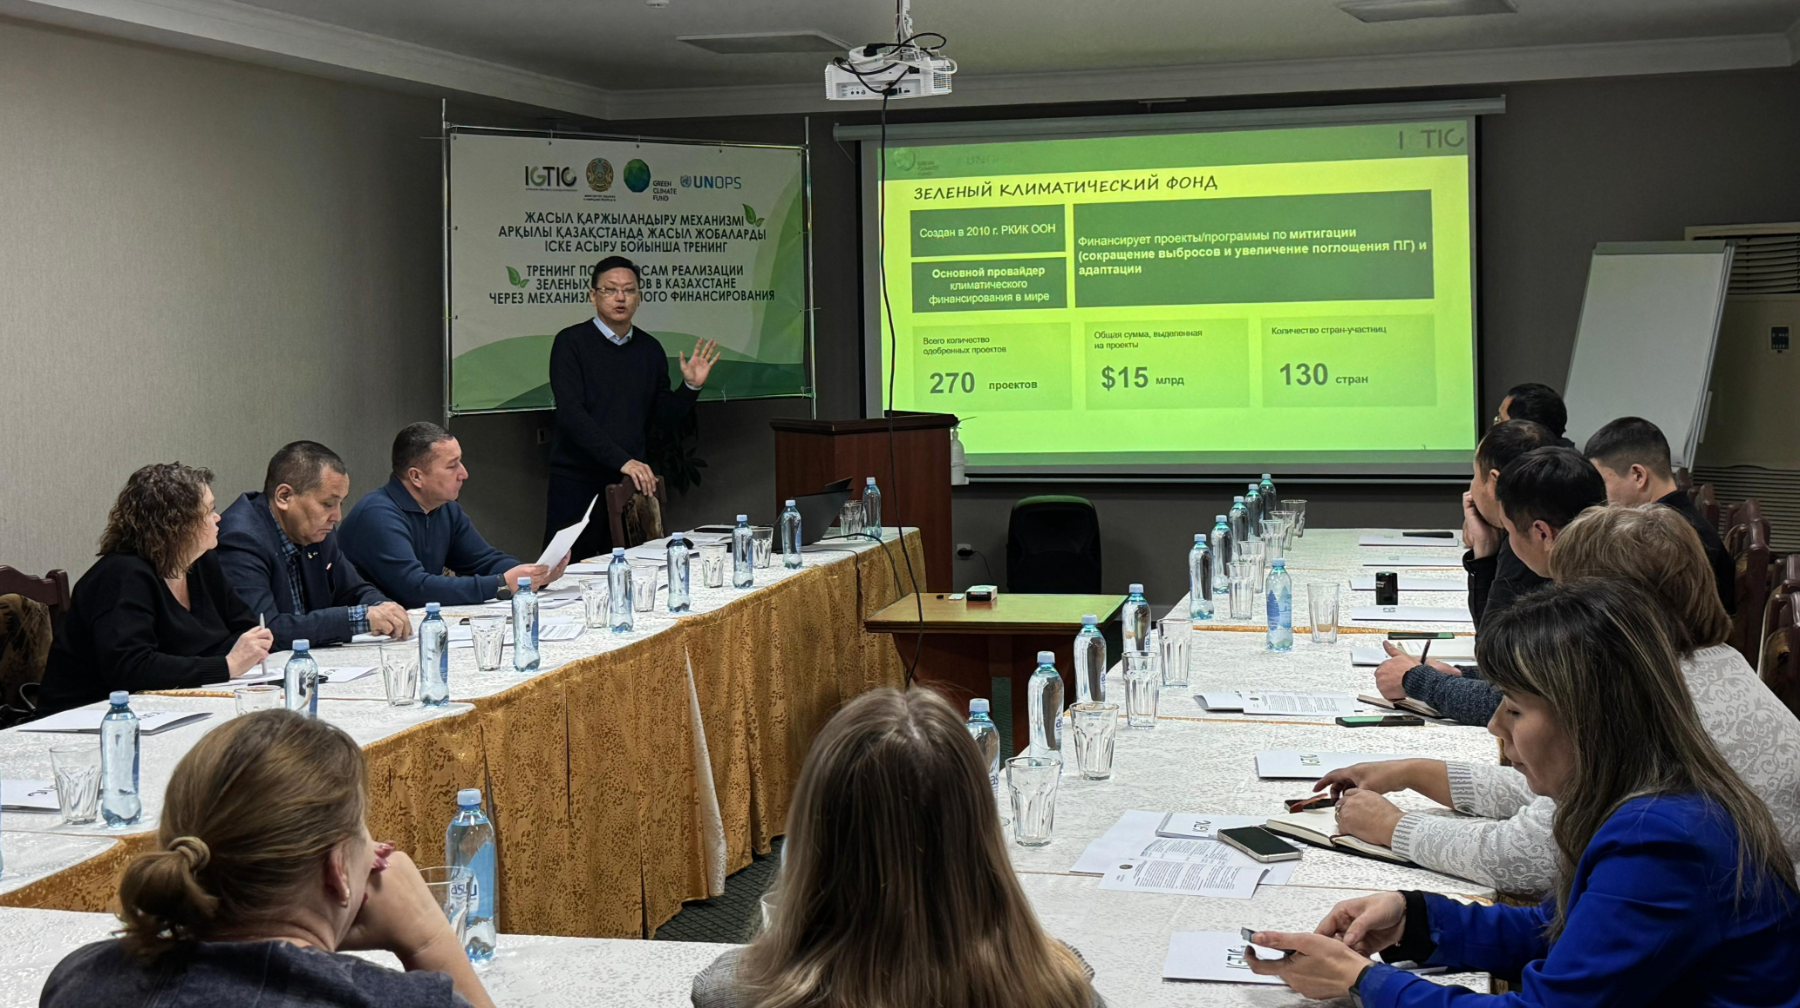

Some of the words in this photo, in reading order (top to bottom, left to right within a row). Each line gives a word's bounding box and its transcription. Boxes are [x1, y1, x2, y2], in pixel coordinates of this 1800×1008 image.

[525, 165, 577, 187] IGTIC
[693, 175, 742, 190] UNOPS
[652, 187, 678, 195] CLIMATE
[914, 181, 993, 200] ЗЕЛЕНЫЙ
[999, 173, 1160, 197] КЛИМАТИЧЕСКИЙ
[1166, 175, 1218, 192] ФОНД
[524, 211, 574, 224] ЖАСЫЛ
[577, 212, 677, 227] ҚАРЖЫЛАНДЫРУ
[680, 214, 745, 227] МЕХАНИЗМІ
[498, 225, 552, 239] АРҚЫЛЫ
[556, 226, 644, 240] ҚАЗАҚСТАНДА
[647, 227, 692, 239] ЖАСЫЛ
[695, 228, 767, 241] ЖОБАЛАРДЫ
[919, 227, 956, 239] Создан
[957, 228, 965, 237] в
[966, 225, 991, 237] 2010
[992, 226, 999, 235] г.
[1001, 224, 1029, 235] РКИК
[1031, 223, 1056, 235] ООН
[1077, 235, 1151, 248] Финансирует
[1154, 231, 1270, 247] проекты/программы
[1272, 230, 1287, 241] по
[1289, 228, 1357, 240] митигации
[544, 240, 572, 252] ІСКЕ
[574, 240, 617, 252] АСЫРУ
[620, 239, 681, 253] БОЙЫНША
[683, 241, 728, 253] ТРЕНИНГ
[1078, 249, 1156, 263] (сокращение
[1158, 247, 1221, 260] выбросов
[1224, 247, 1232, 256] и
[1234, 244, 1309, 259] увеличение
[1312, 241, 1390, 255] поглощения
[1393, 240, 1415, 254] ПГ)
[1418, 241, 1427, 250] и
[526, 265, 576, 277] ТРЕНИНГ
[672, 265, 744, 277] РЕАЛИЗАЦИИ
[931, 267, 985, 279] Основной
[987, 266, 1046, 279] провайдер
[1078, 264, 1143, 276] адаптации
[536, 278, 590, 291] ЗЕЛЕНЫХ
[655, 278, 662, 289] В
[665, 277, 737, 289] КАЗАХСТАНЕ
[949, 280, 1028, 291] климатического
[489, 292, 524, 305] ЧЕРЕЗ
[671, 289, 775, 302] ФИНАНСИРОВАНИЯ
[928, 293, 1013, 306] финансирования
[1015, 294, 1021, 302] в
[1024, 292, 1050, 303] мире
[1094, 330, 1122, 340] Общая
[1153, 329, 1203, 339] выделенная
[1271, 326, 1319, 335] Количество
[1320, 325, 1387, 336] стран-участниц
[922, 336, 945, 346] Всего
[946, 335, 990, 345] количество
[1094, 342, 1104, 350] на
[1105, 341, 1139, 351] проекты
[922, 346, 970, 356] одобренных
[971, 345, 1007, 356] проектов
[1101, 365, 1149, 391] $15
[1155, 376, 1185, 387] млрд
[1279, 362, 1329, 386] 130
[1335, 375, 1369, 387] стран
[929, 371, 975, 394] 270
[988, 381, 1038, 392] проектов
